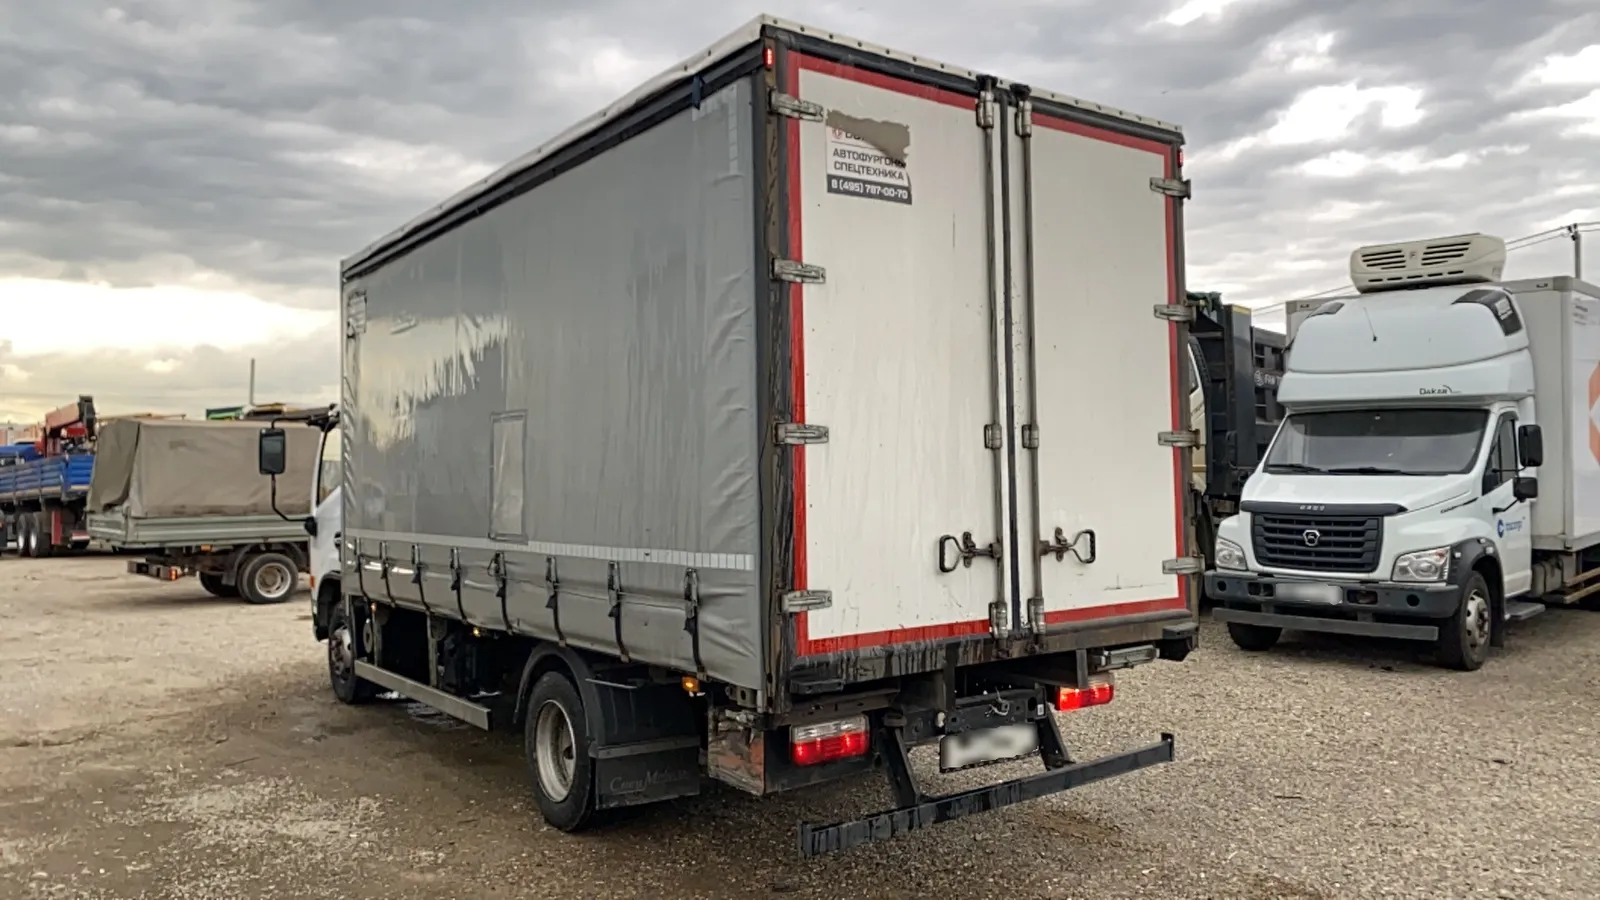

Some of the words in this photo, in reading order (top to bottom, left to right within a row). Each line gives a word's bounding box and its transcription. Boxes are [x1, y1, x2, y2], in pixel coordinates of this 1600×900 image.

[834, 161, 904, 180] СПЕЦТЕХНИКА
[832, 179, 838, 189] 8
[839, 180, 864, 192] (495)
